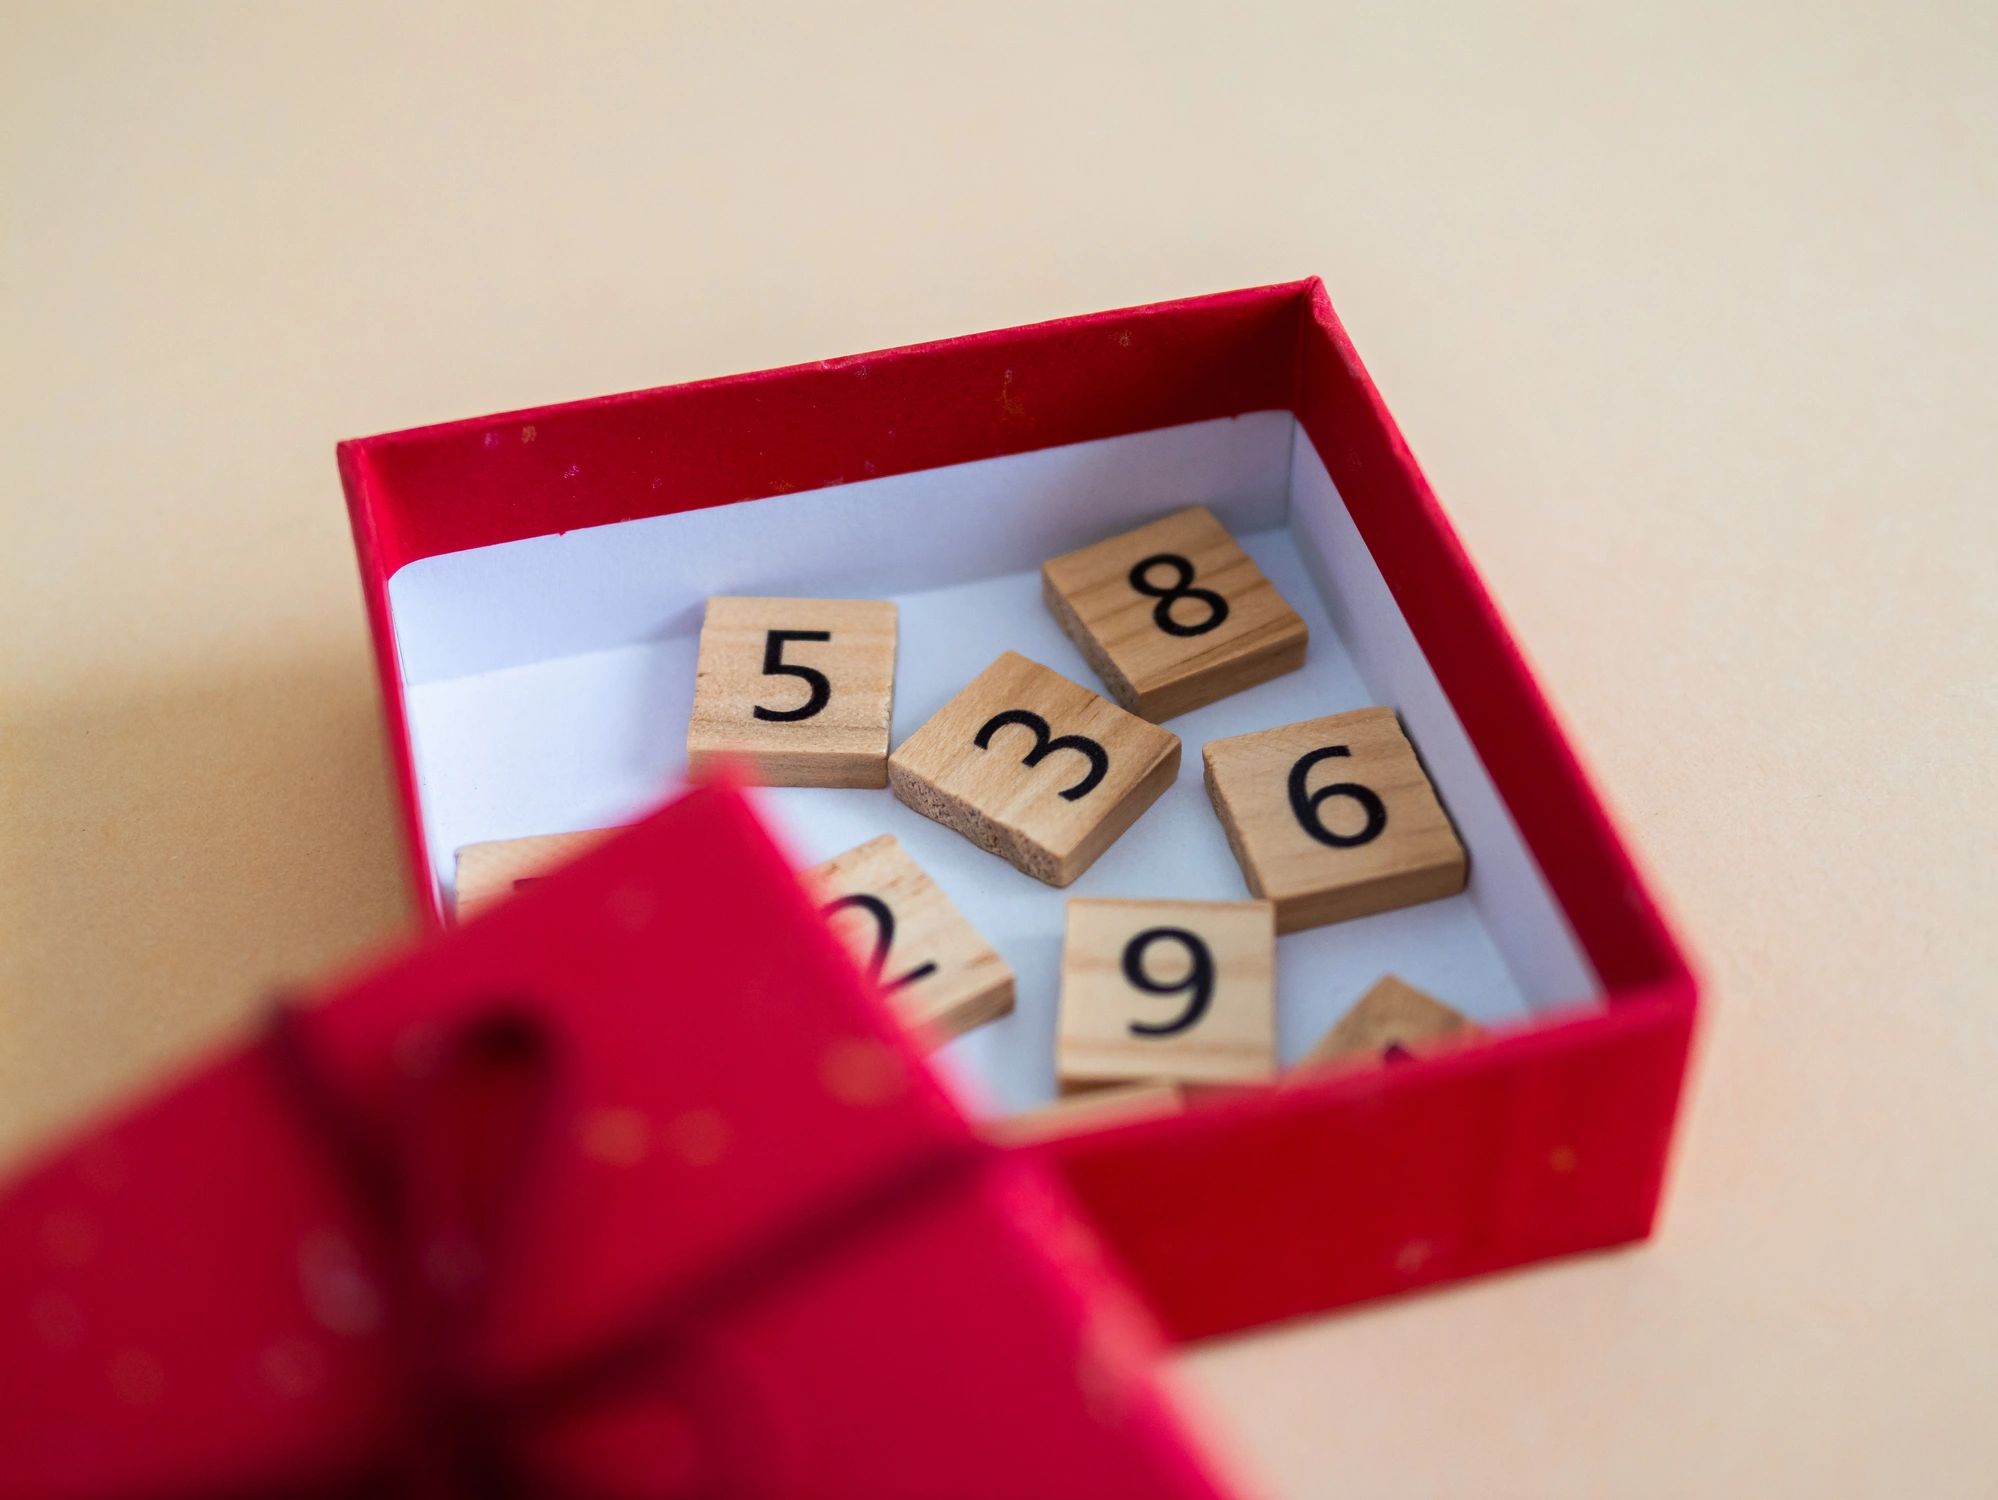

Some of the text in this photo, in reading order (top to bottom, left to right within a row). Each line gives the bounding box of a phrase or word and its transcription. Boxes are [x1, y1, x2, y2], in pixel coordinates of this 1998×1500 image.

[1127, 552, 1230, 638] 8
[752, 629, 832, 723] 5
[973, 708, 1110, 803] 3
[1287, 744, 1388, 849] 6
[821, 893, 938, 997] 2
[1121, 927, 1216, 1038] 9
